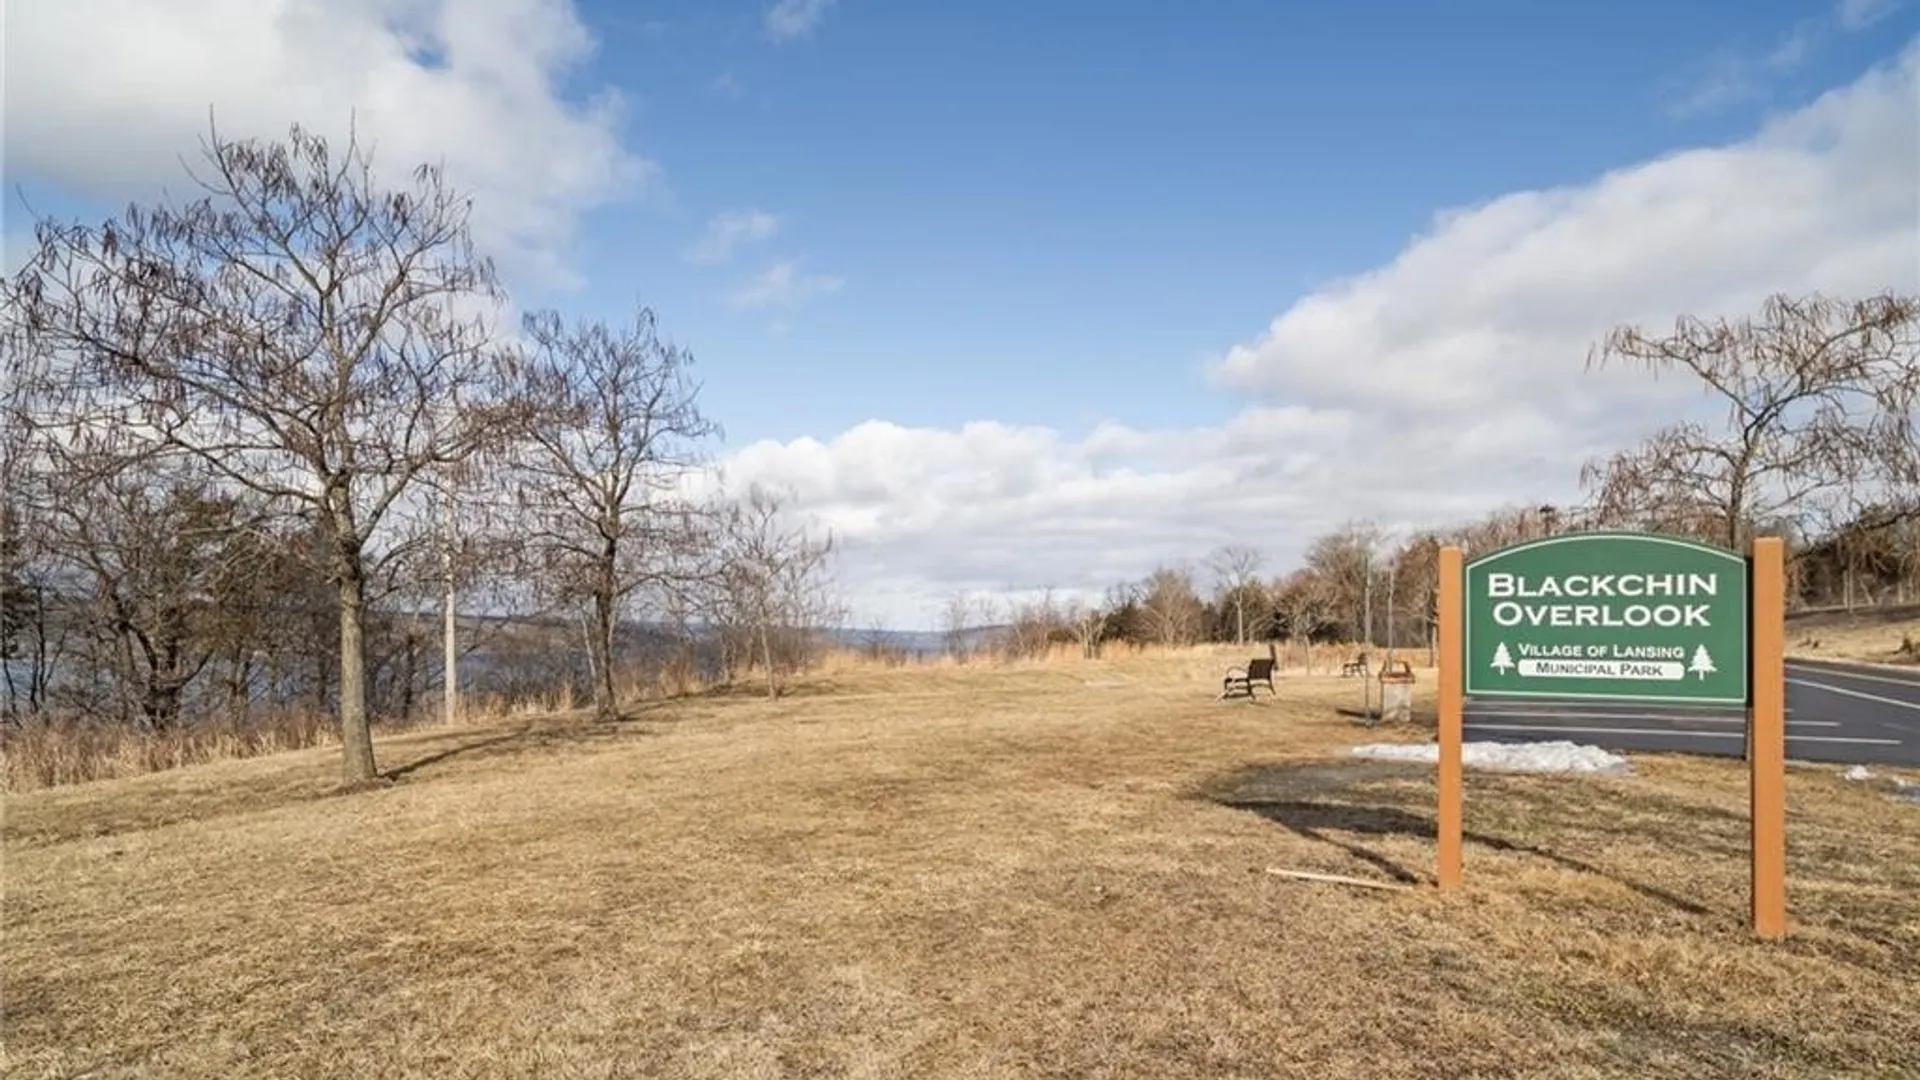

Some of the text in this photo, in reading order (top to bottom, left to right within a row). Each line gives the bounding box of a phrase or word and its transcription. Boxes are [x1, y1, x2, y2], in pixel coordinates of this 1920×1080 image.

[1488, 573, 1717, 597] BLACKCHIN
[1493, 602, 1711, 627] OVERLOOK
[1518, 643, 1685, 659] VILLAGE OF LANSING
[1535, 661, 1663, 677] MUNICIPAL PARK
